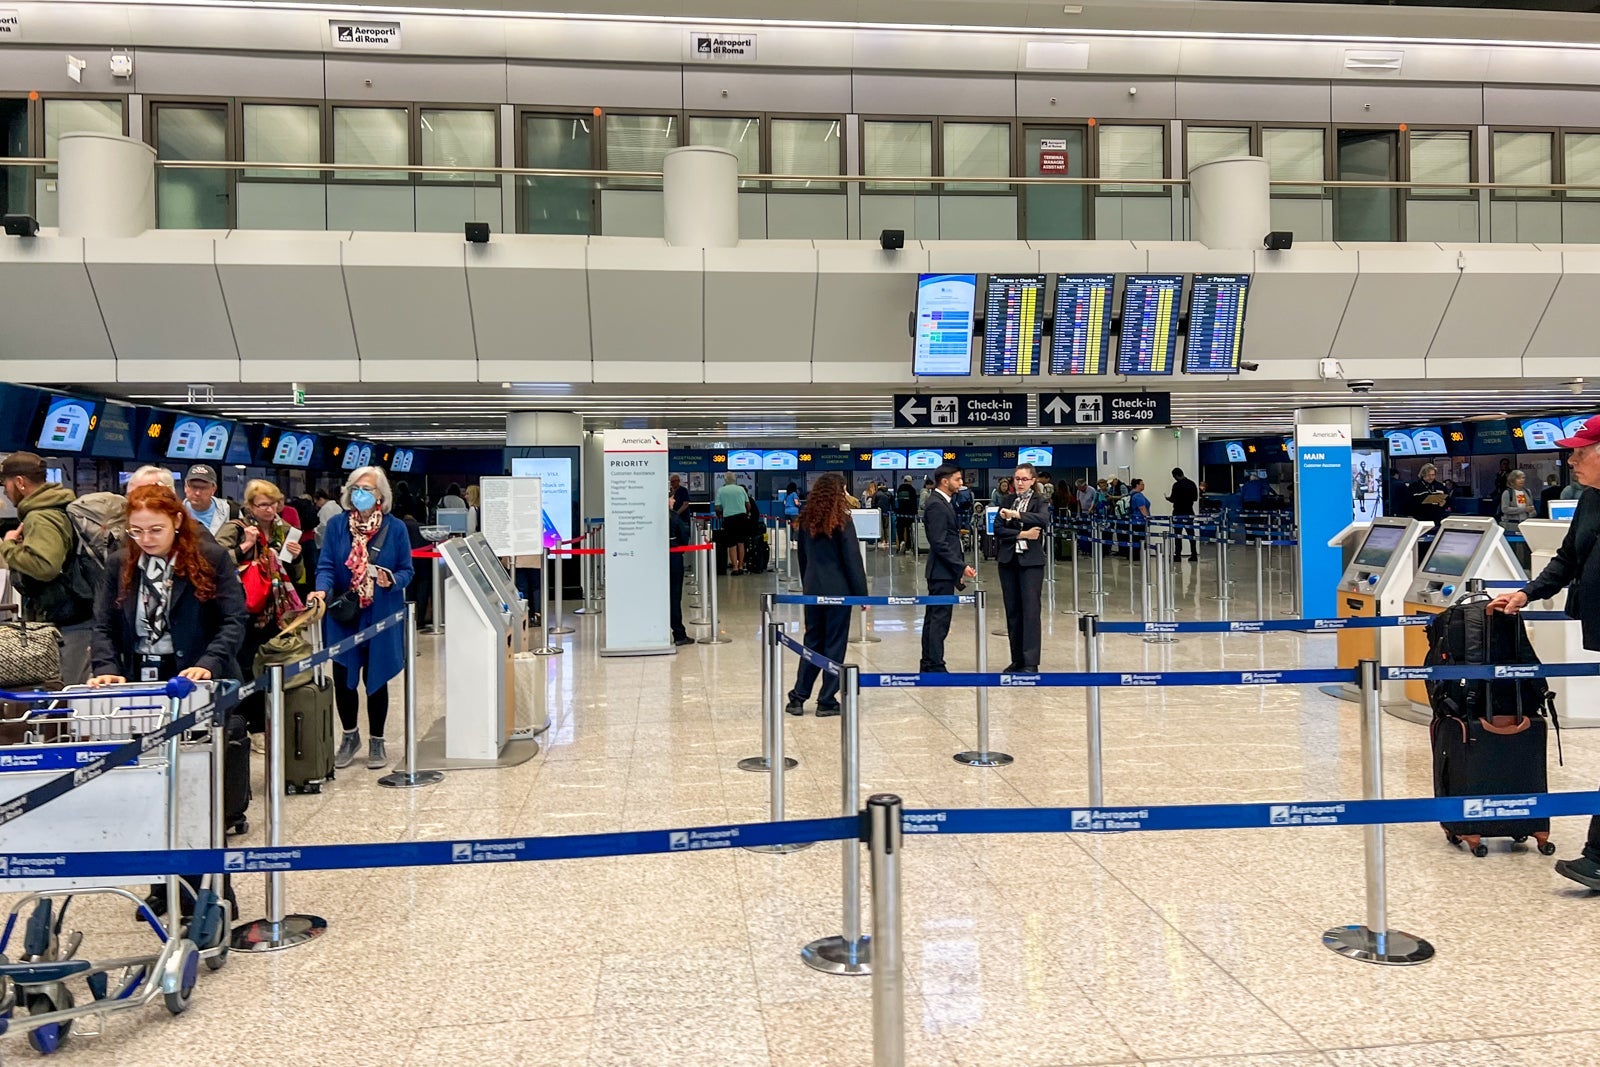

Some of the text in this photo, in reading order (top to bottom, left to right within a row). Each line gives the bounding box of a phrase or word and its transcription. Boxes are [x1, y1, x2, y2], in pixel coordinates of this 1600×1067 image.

[355, 26, 396, 36] Aeroporti
[713, 38, 751, 47] Aeroporti
[967, 400, 1012, 410] Check-in
[1112, 398, 1156, 408] Check-in
[967, 411, 1010, 422] 410-430
[1112, 410, 1154, 420] 386-409
[148, 423, 162, 438] 408
[712, 454, 726, 462] 399
[1484, 797, 1537, 808] Aeroporti
[1290, 804, 1345, 815] Aeroporti
[1496, 808, 1530, 816] Roma
[903, 812, 946, 823] roporti
[1092, 810, 1149, 820] Aeroporti
[1303, 815, 1338, 823] Roma
[903, 823, 938, 832] Roma
[1105, 820, 1141, 828] Roma
[690, 828, 739, 839] Aeroporti
[474, 841, 525, 852] Aeroporti
[247, 850, 301, 860] Aeroporti
[10, 856, 65, 866] Aeroporti
[259, 861, 291, 869] Roma
[22, 866, 55, 876] Roma
